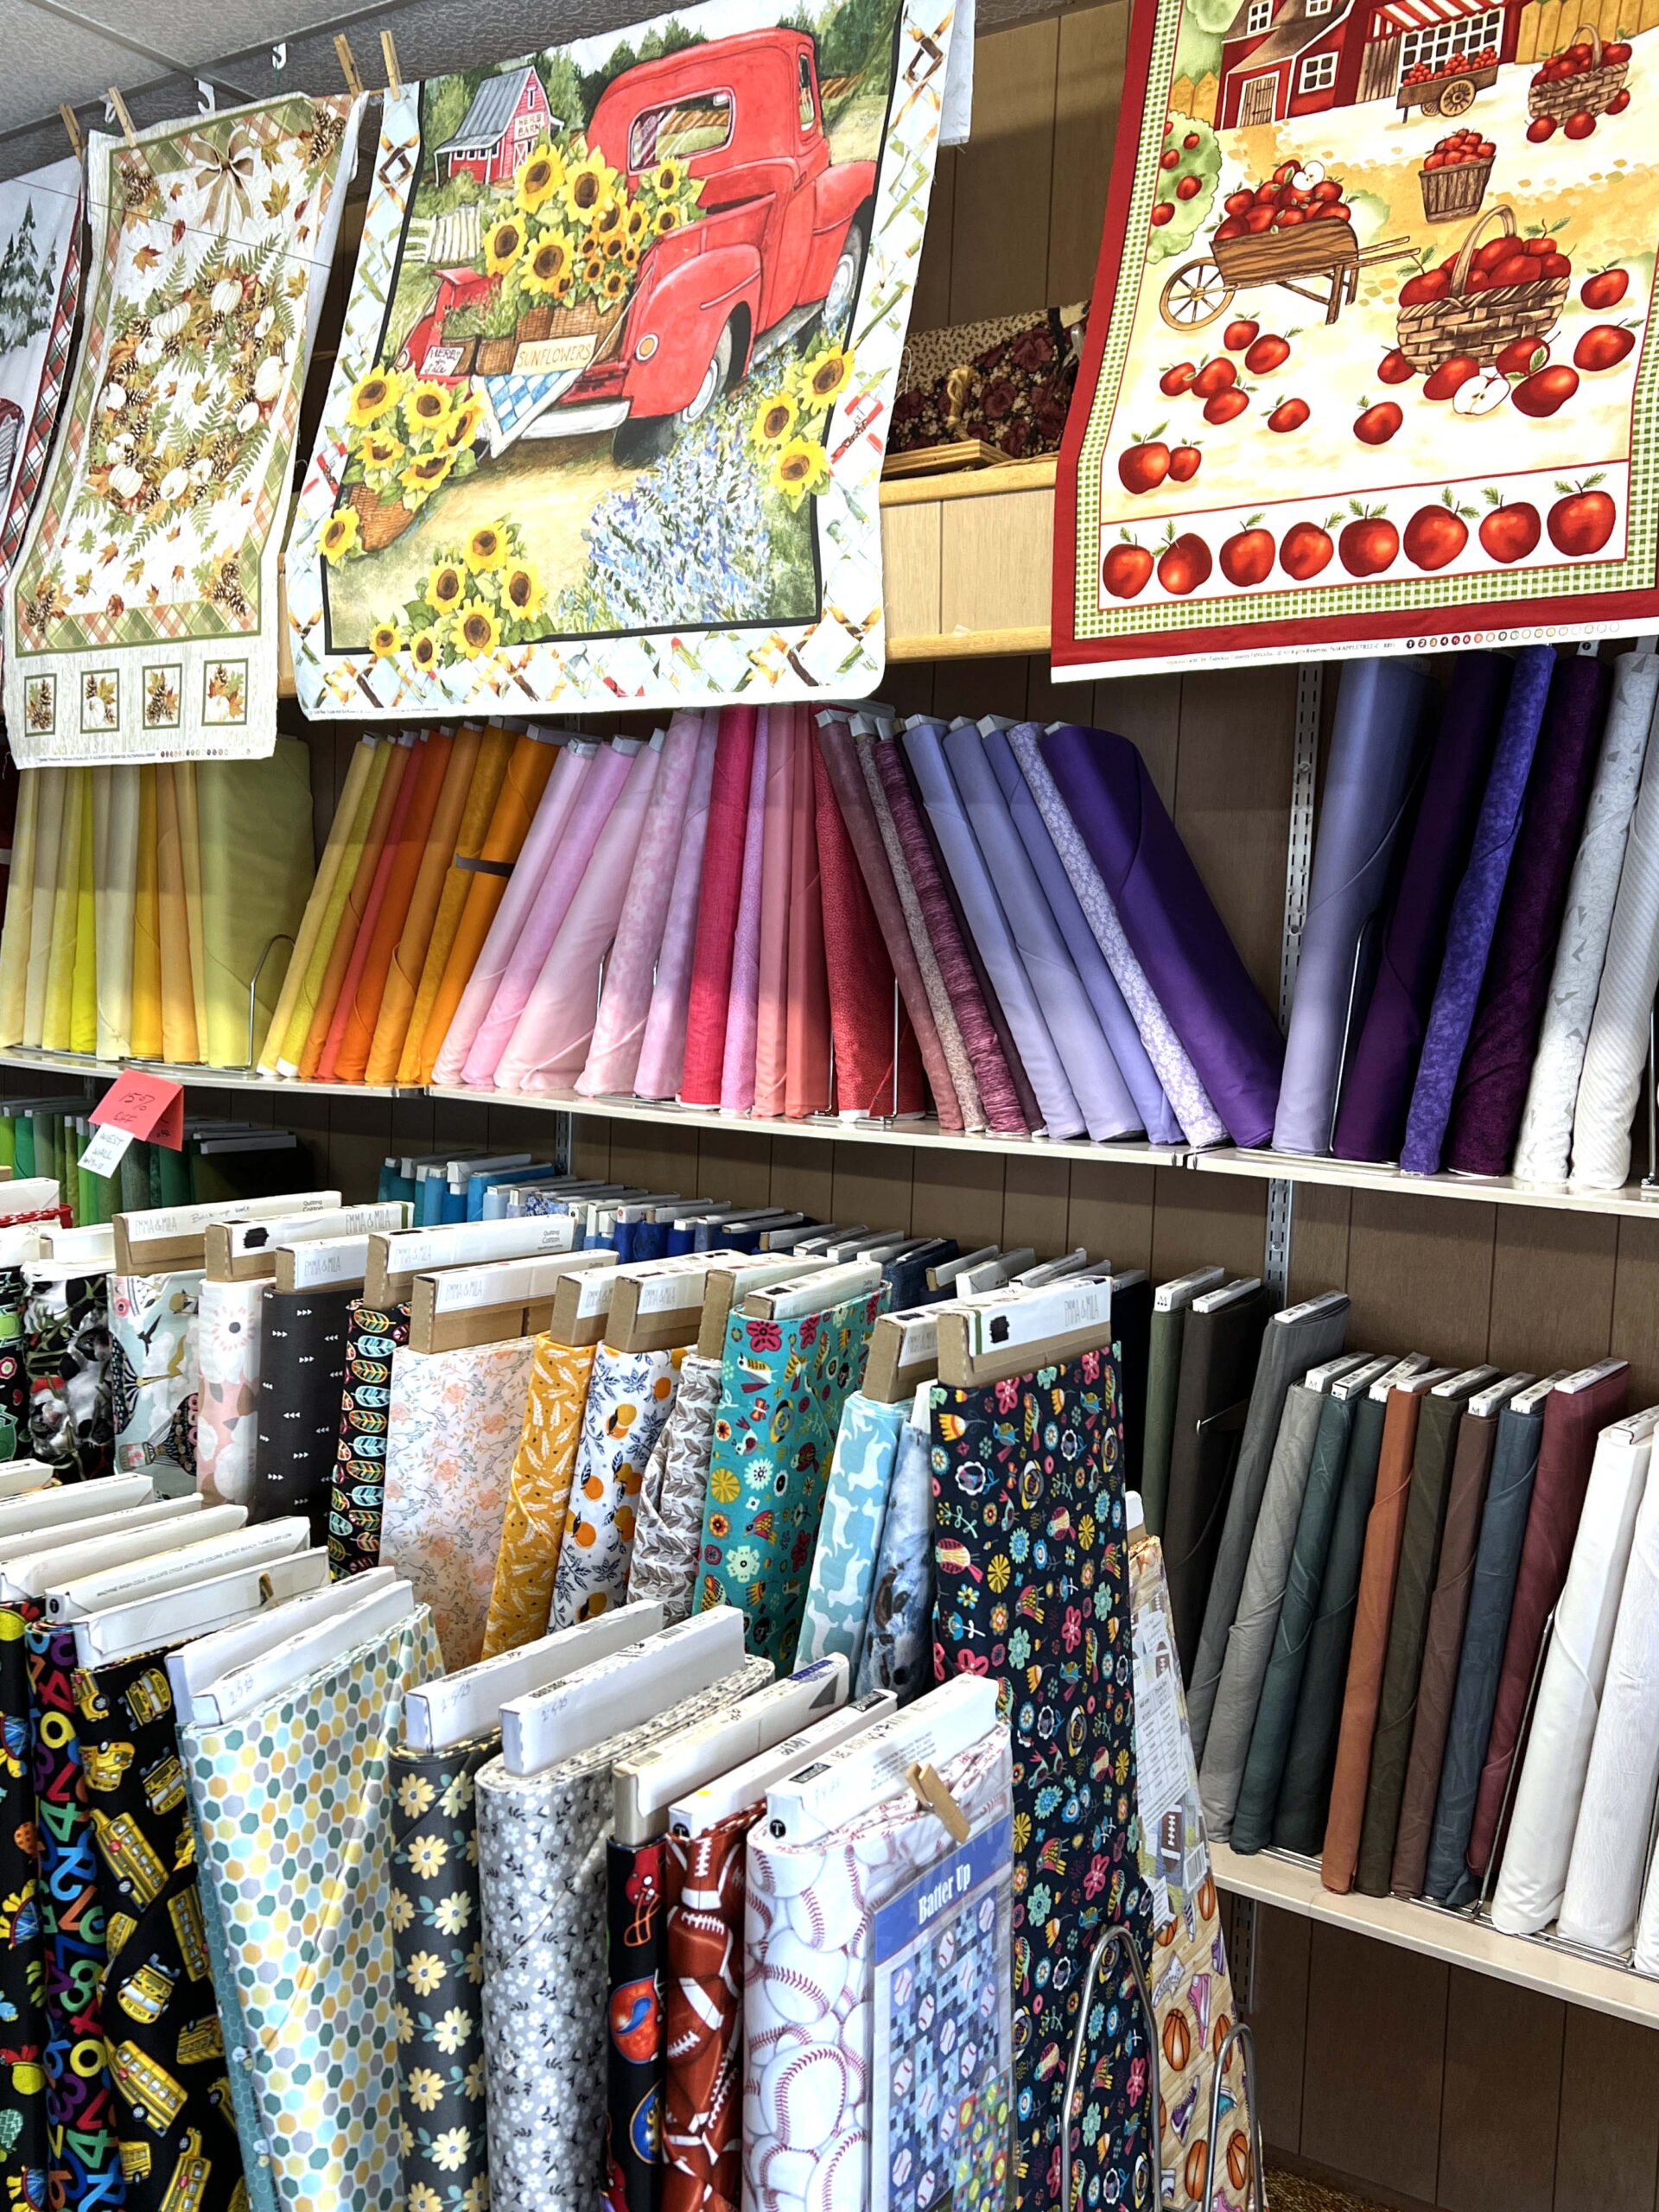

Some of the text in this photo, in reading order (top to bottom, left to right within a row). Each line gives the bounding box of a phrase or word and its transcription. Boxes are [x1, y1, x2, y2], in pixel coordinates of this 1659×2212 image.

[430, 347, 461, 359] HERBS
[518, 344, 592, 368] SUNFLOWERS
[119, 1092, 155, 1110] 15%
[135, 1219, 155, 1236] EMMA
[346, 1210, 391, 1235] EMMA & MILA
[305, 1255, 340, 1277] EMMA & MILA
[1065, 1294, 1099, 1326] EMMA & MILA
[772, 1821, 783, 1835] T
[918, 1864, 971, 1925] Batter Up
